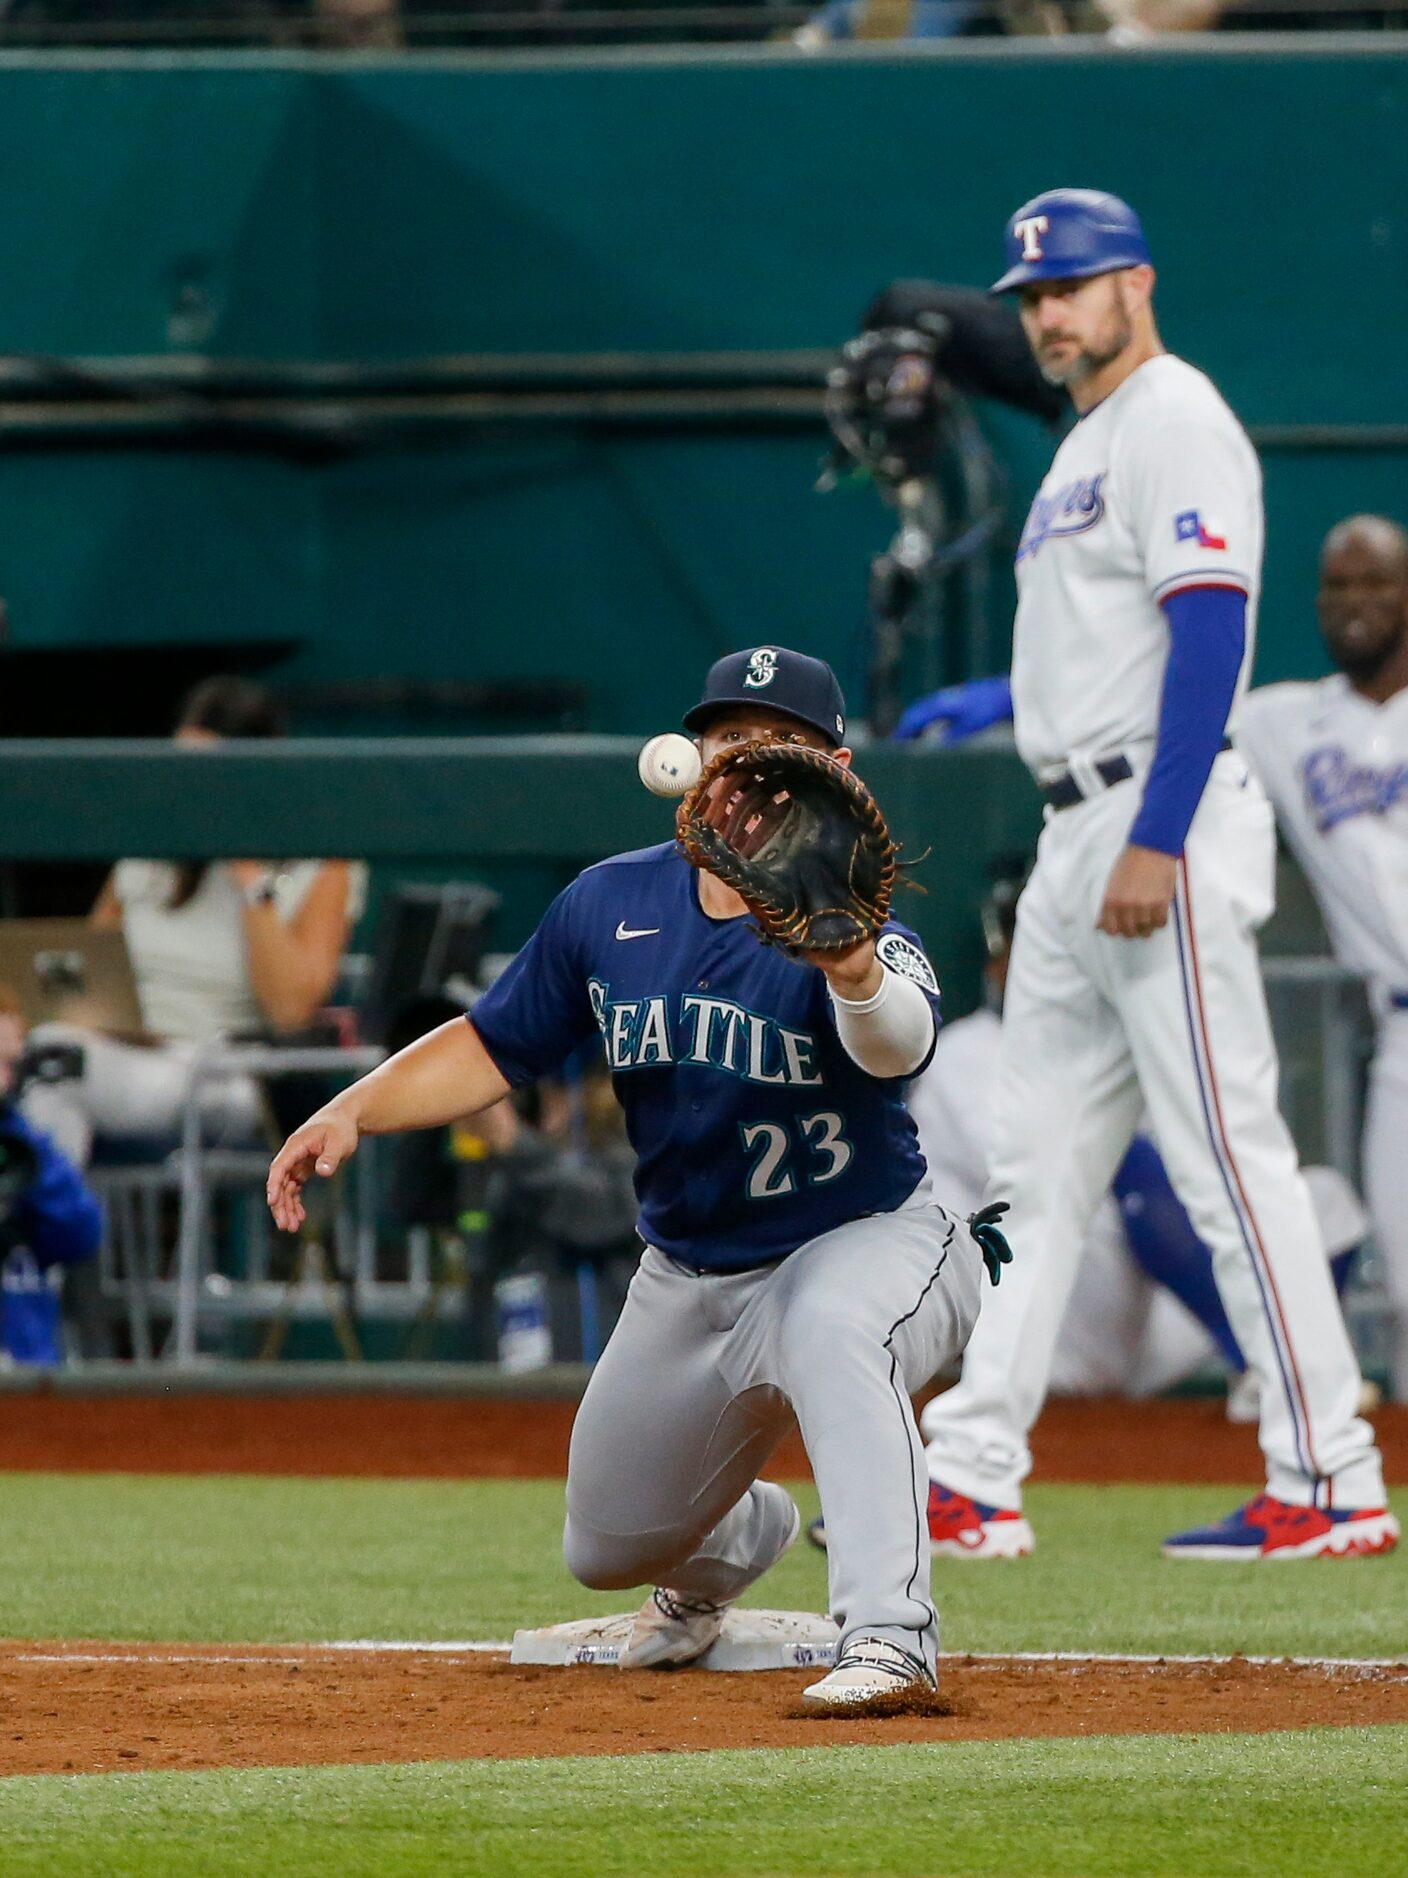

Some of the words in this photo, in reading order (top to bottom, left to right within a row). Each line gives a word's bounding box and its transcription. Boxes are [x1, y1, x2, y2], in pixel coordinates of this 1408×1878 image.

[1014, 215, 1049, 261] T
[743, 648, 778, 690] S
[587, 977, 823, 1086] SEATTLE
[738, 1109, 853, 1199] 23
